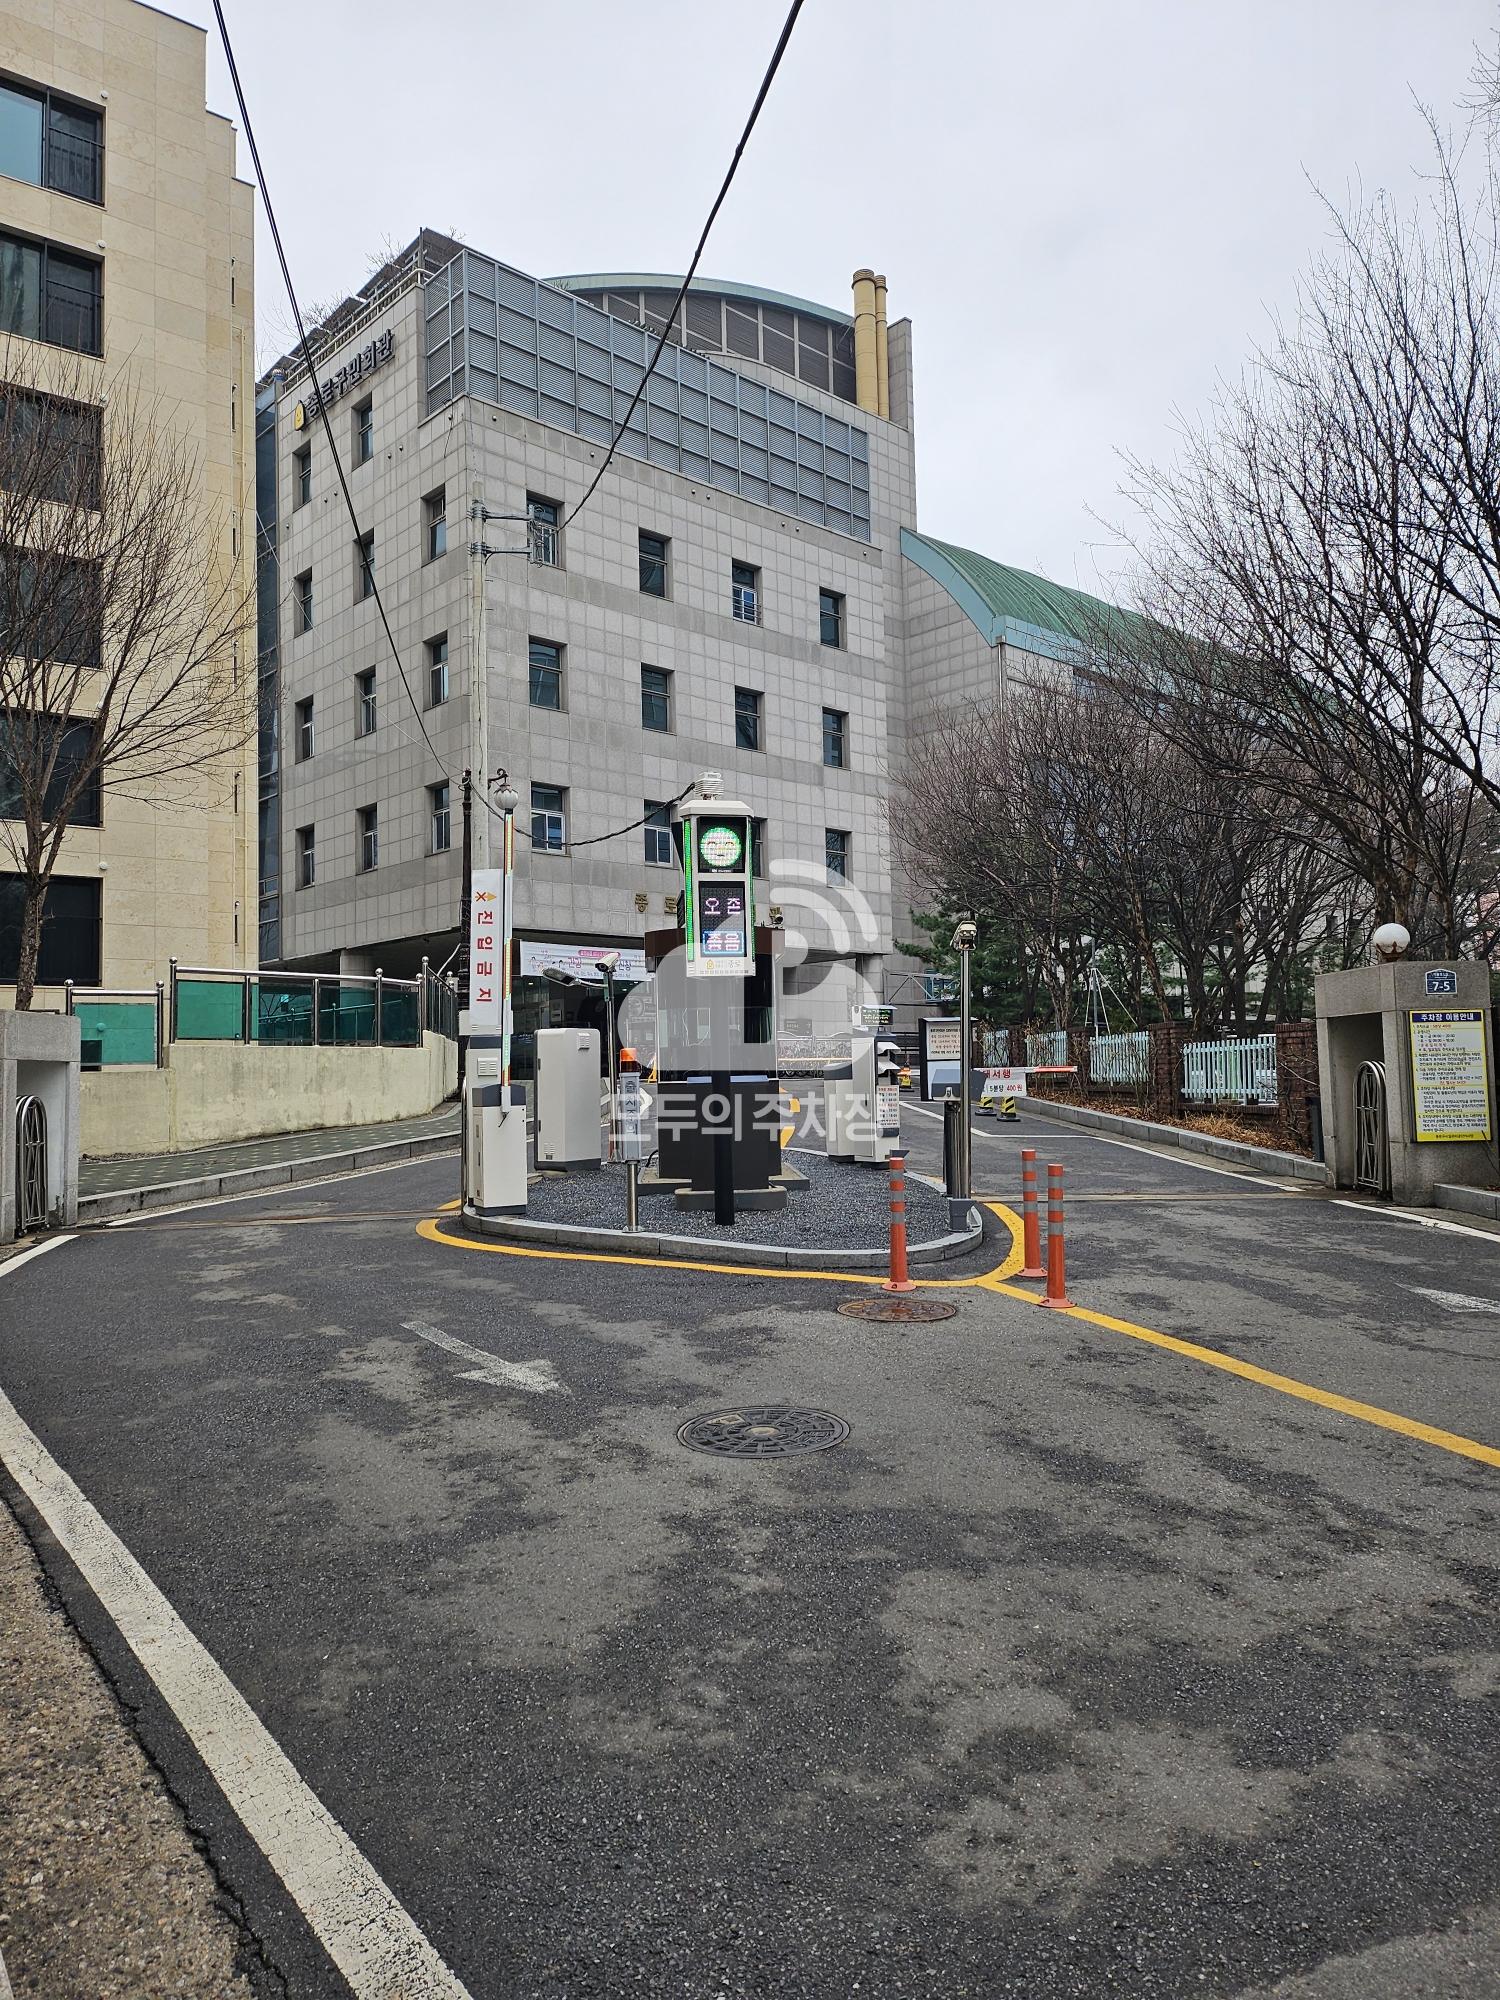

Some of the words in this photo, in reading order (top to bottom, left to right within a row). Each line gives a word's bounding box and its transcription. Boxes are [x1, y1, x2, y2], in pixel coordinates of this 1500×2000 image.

[305, 328, 395, 418] 종로구민회관
[704, 898, 740, 915] 오존
[476, 910, 493, 1002] 진입금지
[1432, 981, 1451, 991] 7-5
[1421, 1013, 1443, 1021] 주차장
[1445, 1012, 1474, 1021] 이용안내
